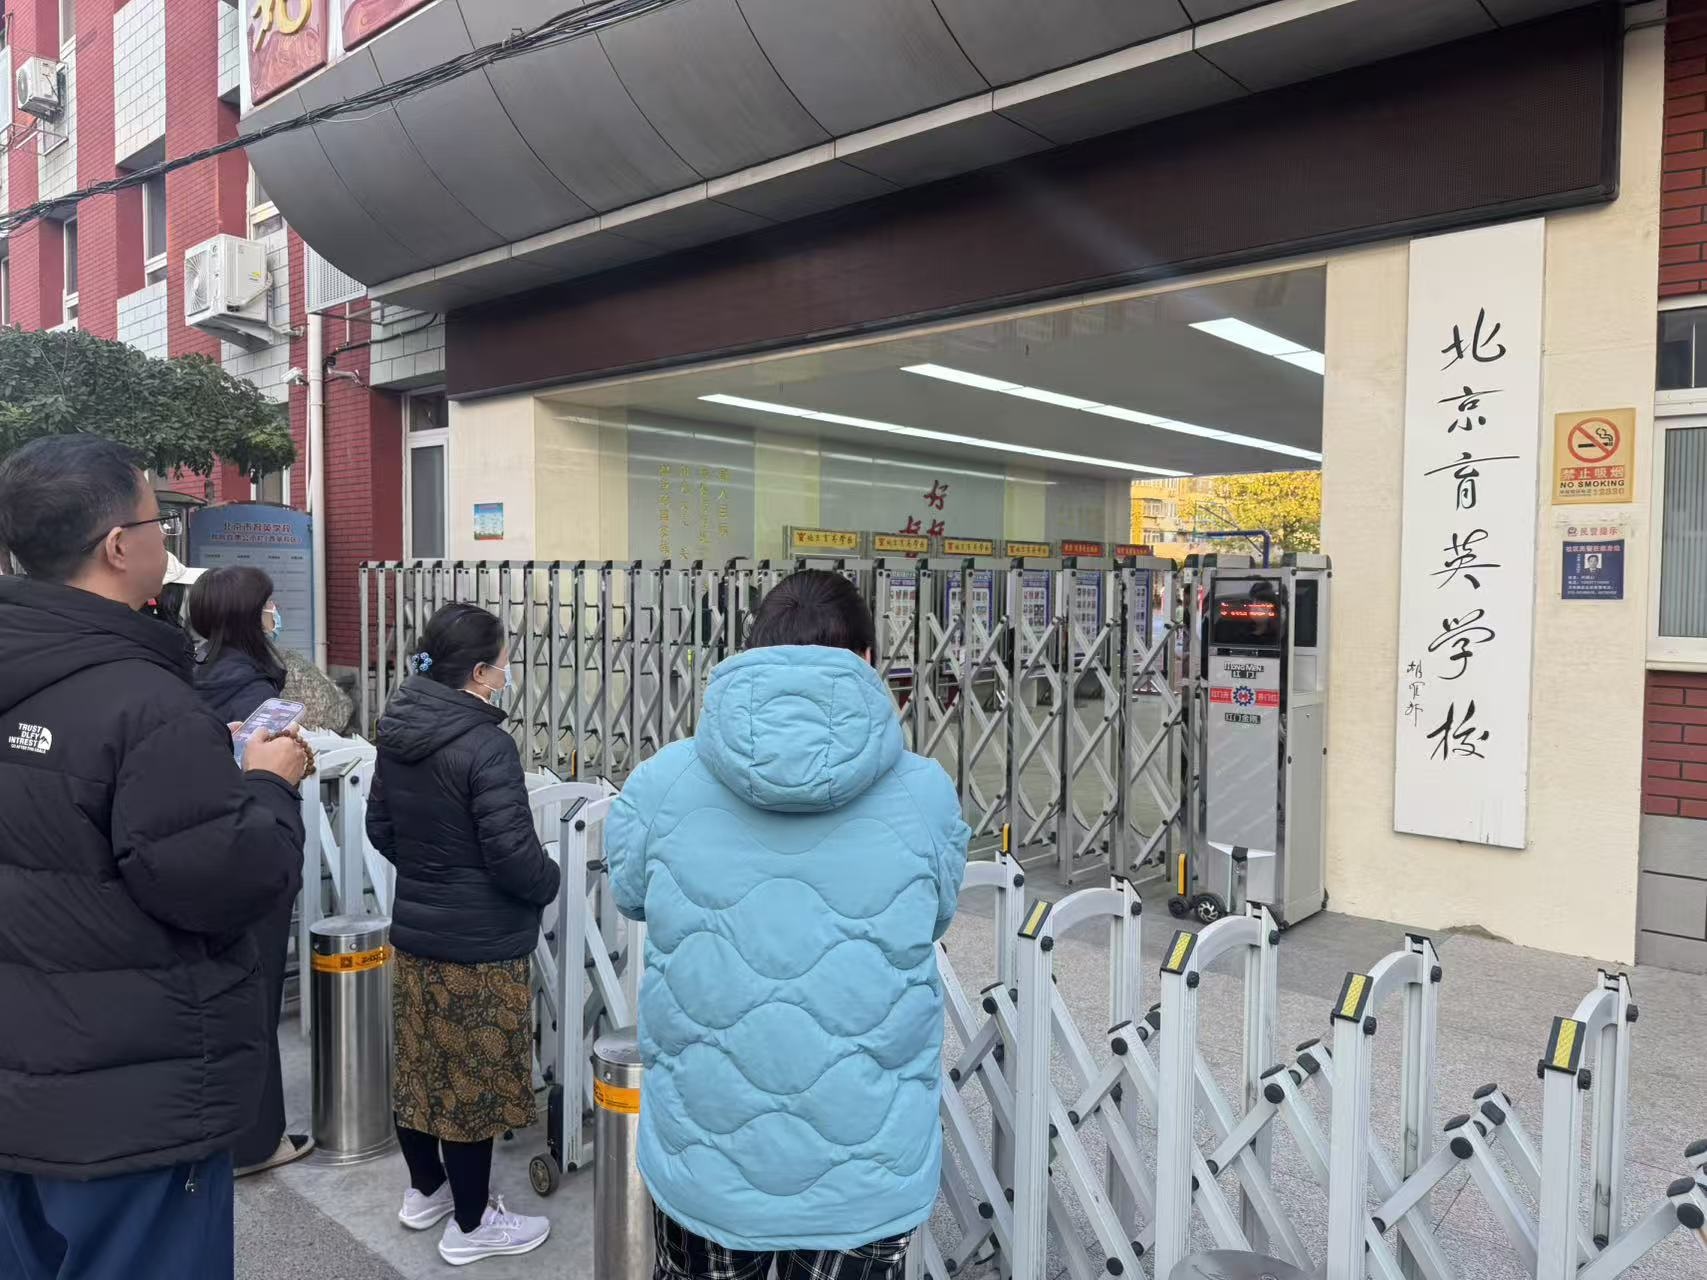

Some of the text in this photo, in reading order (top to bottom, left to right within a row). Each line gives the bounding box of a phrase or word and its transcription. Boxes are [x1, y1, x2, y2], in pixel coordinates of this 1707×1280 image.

[1560, 466, 1624, 480] 禁止吸烟
[1560, 480, 1625, 489] NO SMOKING
[1424, 307, 1520, 761] 北京育英学校
[19, 723, 42, 733] TRUST
